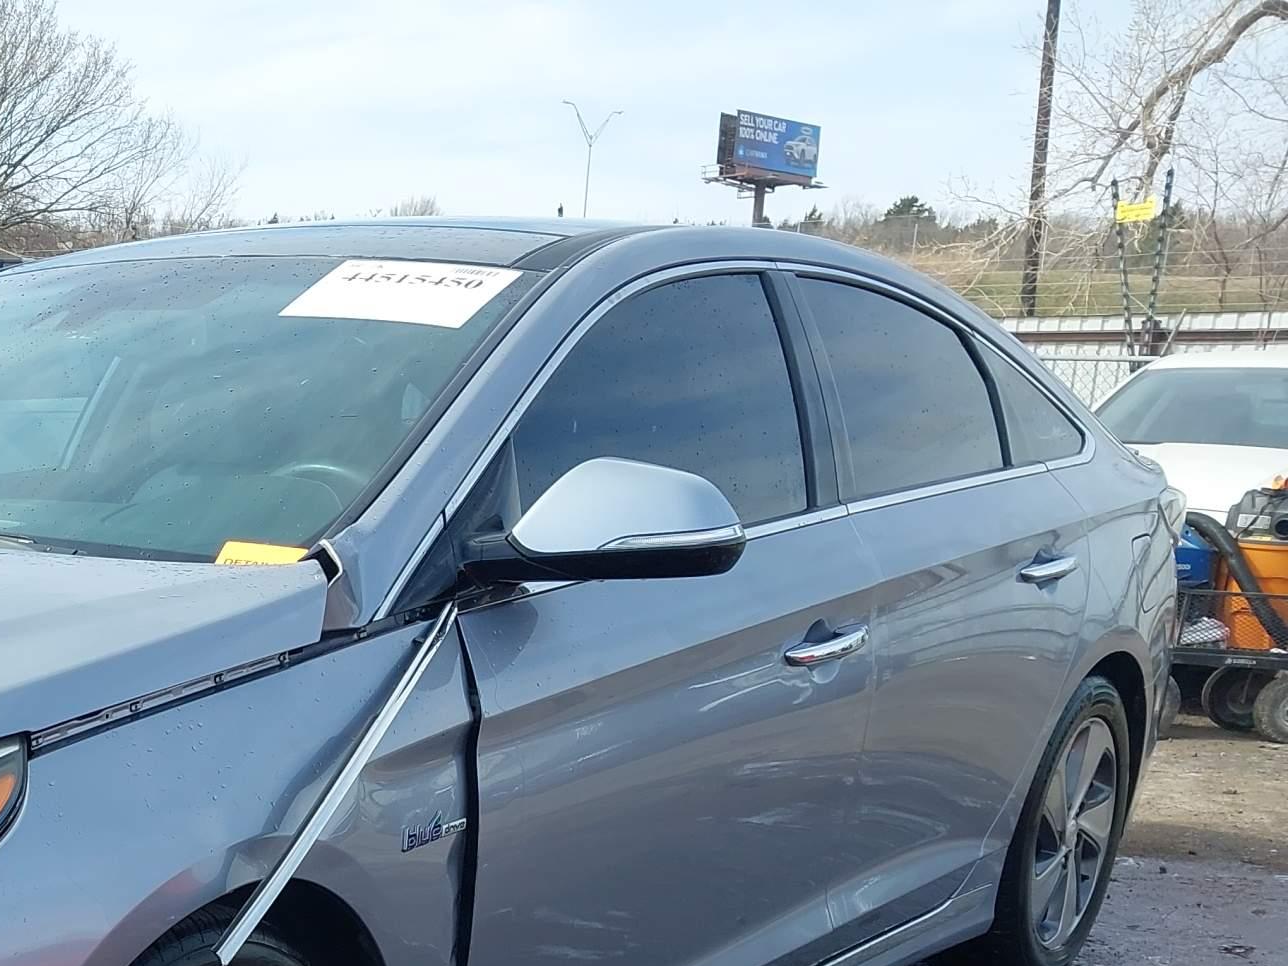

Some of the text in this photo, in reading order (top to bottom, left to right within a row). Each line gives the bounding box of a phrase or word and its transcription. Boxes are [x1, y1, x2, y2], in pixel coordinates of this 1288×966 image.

[739, 113, 787, 133] SELL YOUR CAR
[739, 127, 779, 144] 100% ONLINE
[341, 271, 484, 290] 44515450
